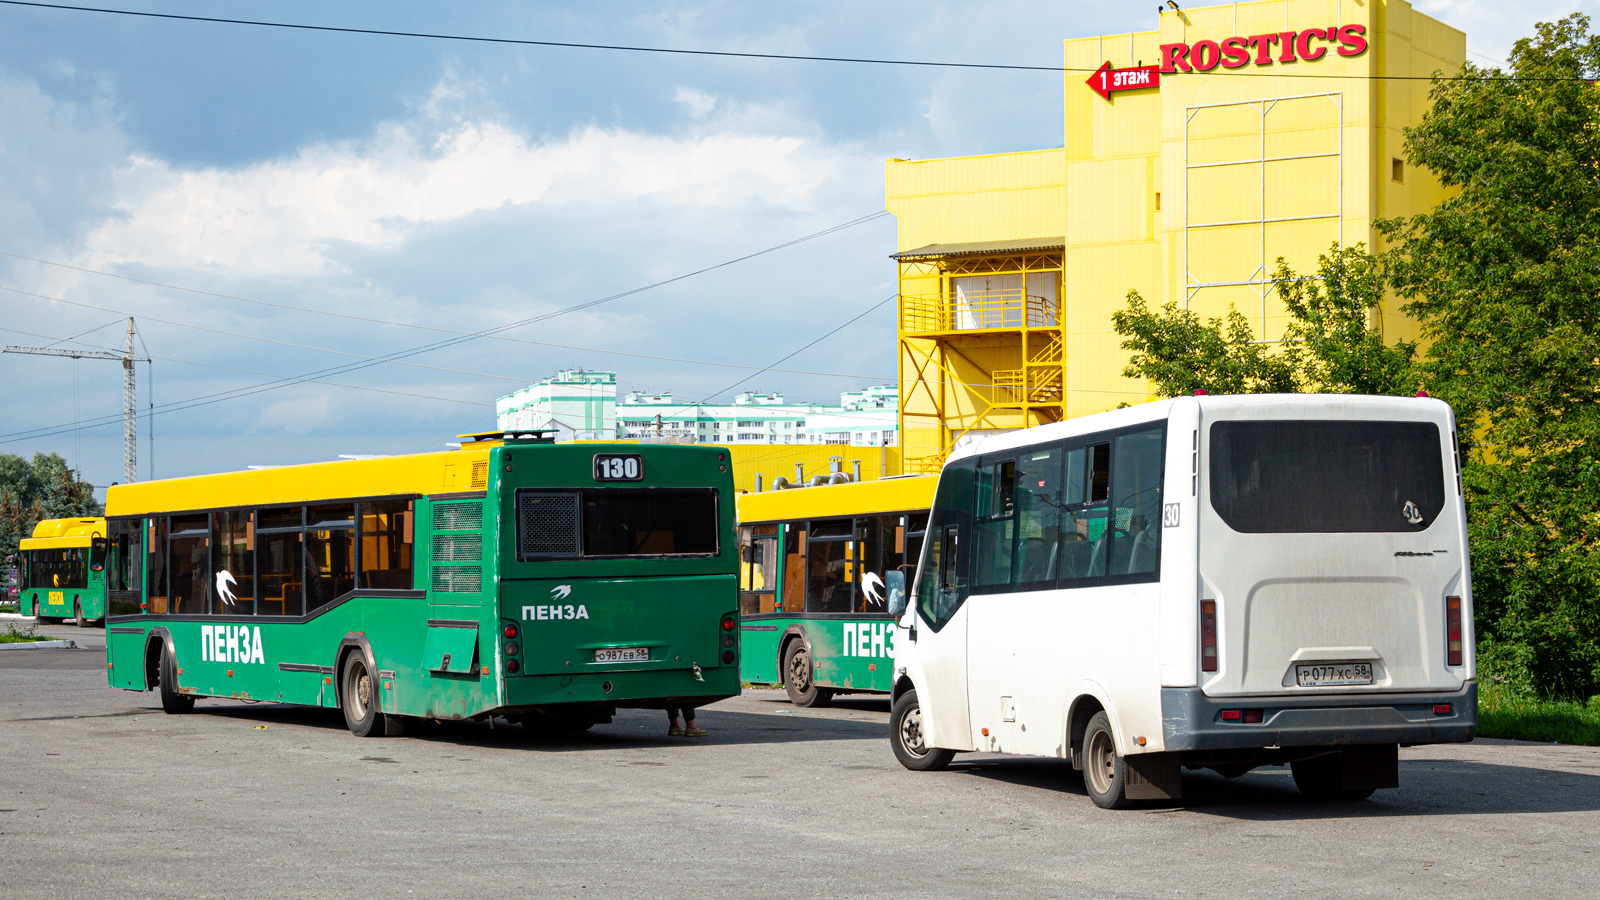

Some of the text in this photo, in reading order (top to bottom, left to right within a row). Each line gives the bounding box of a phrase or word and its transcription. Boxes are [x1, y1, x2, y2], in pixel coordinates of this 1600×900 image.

[1159, 24, 1367, 73] ROSTIC'S
[1100, 70, 1150, 90] 1 этаж
[600, 457, 638, 478] 130
[1165, 504, 1179, 526] 30
[1403, 504, 1421, 520] 30
[521, 604, 590, 620] ПЕНЗА
[201, 624, 265, 664] ПЕНЗА
[843, 622, 898, 659] ПЕНЗ
